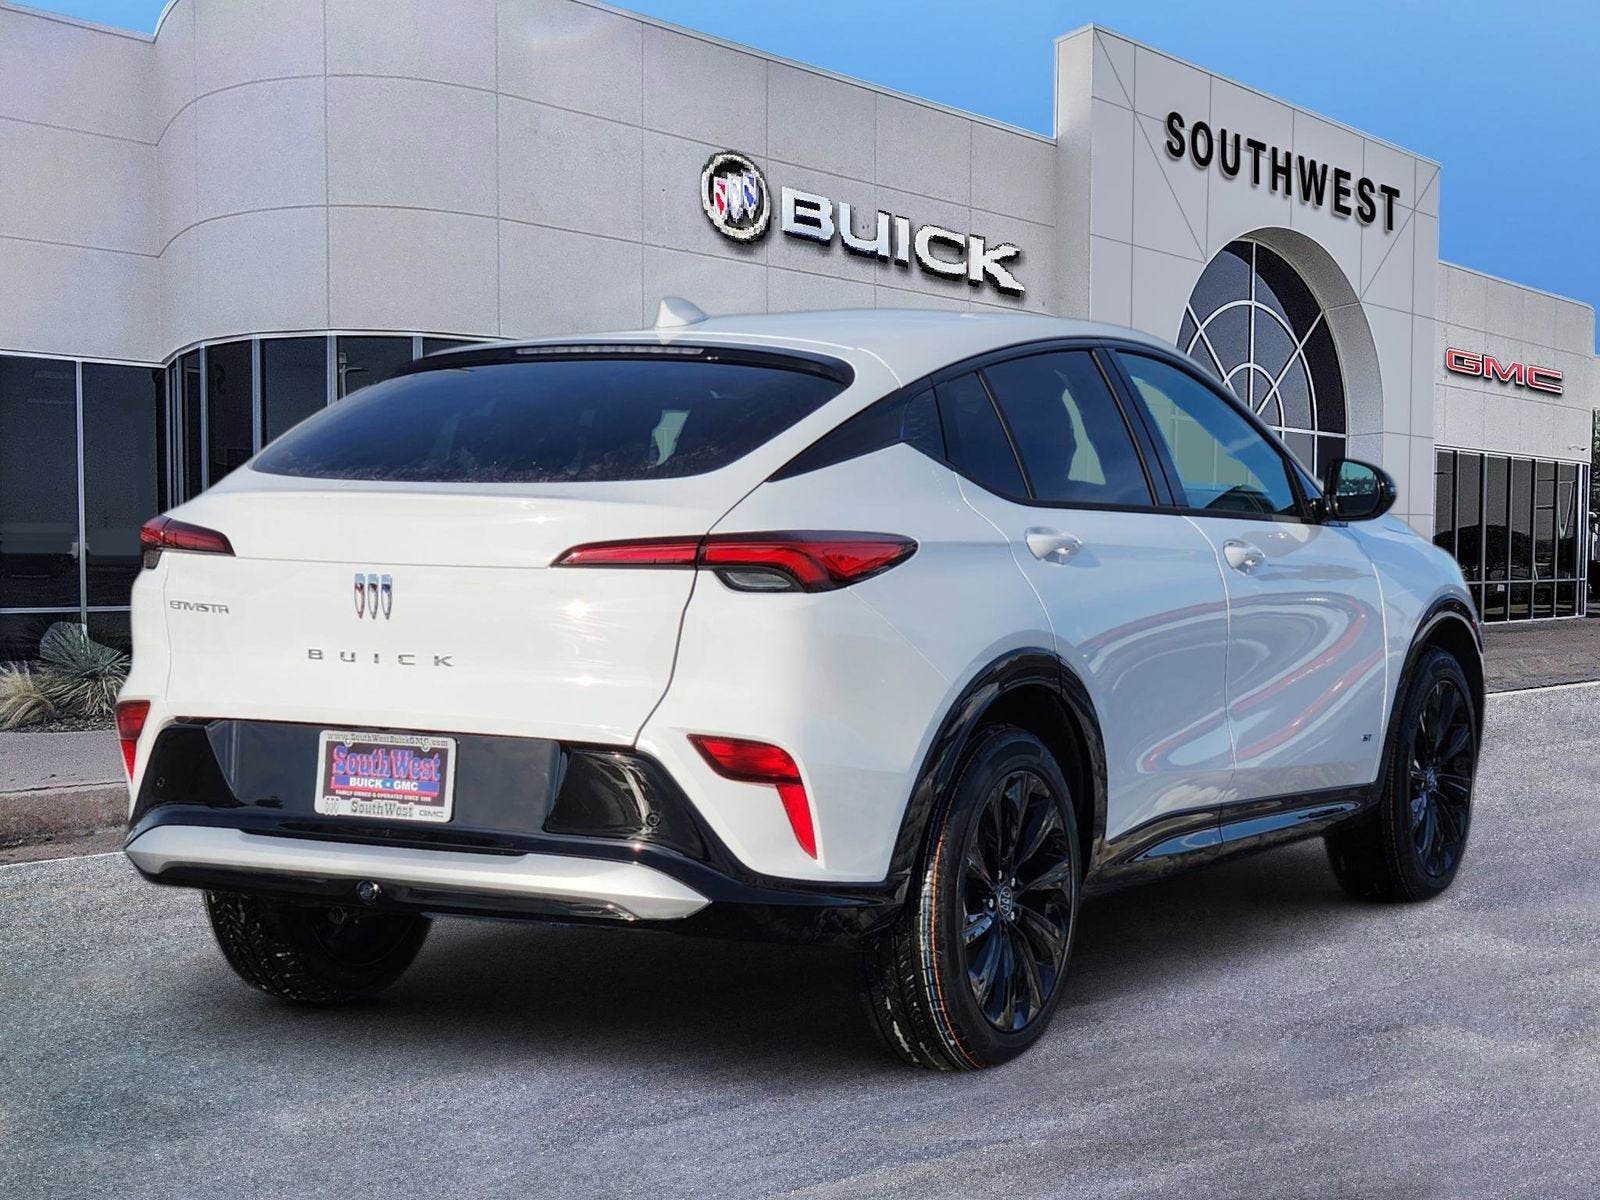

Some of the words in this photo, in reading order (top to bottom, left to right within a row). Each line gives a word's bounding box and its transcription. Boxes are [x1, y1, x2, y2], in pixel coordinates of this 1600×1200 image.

[1166, 111, 1400, 232] SOUTHWEST
[781, 186, 1026, 297] BUICK
[1446, 347, 1563, 395] GMC
[307, 648, 454, 668] BUICK
[332, 745, 441, 782] SouthWest
[349, 777, 383, 789] BUICK
[393, 780, 419, 791] GMC
[351, 800, 414, 818] SouthWest
[418, 810, 444, 818] GMC
